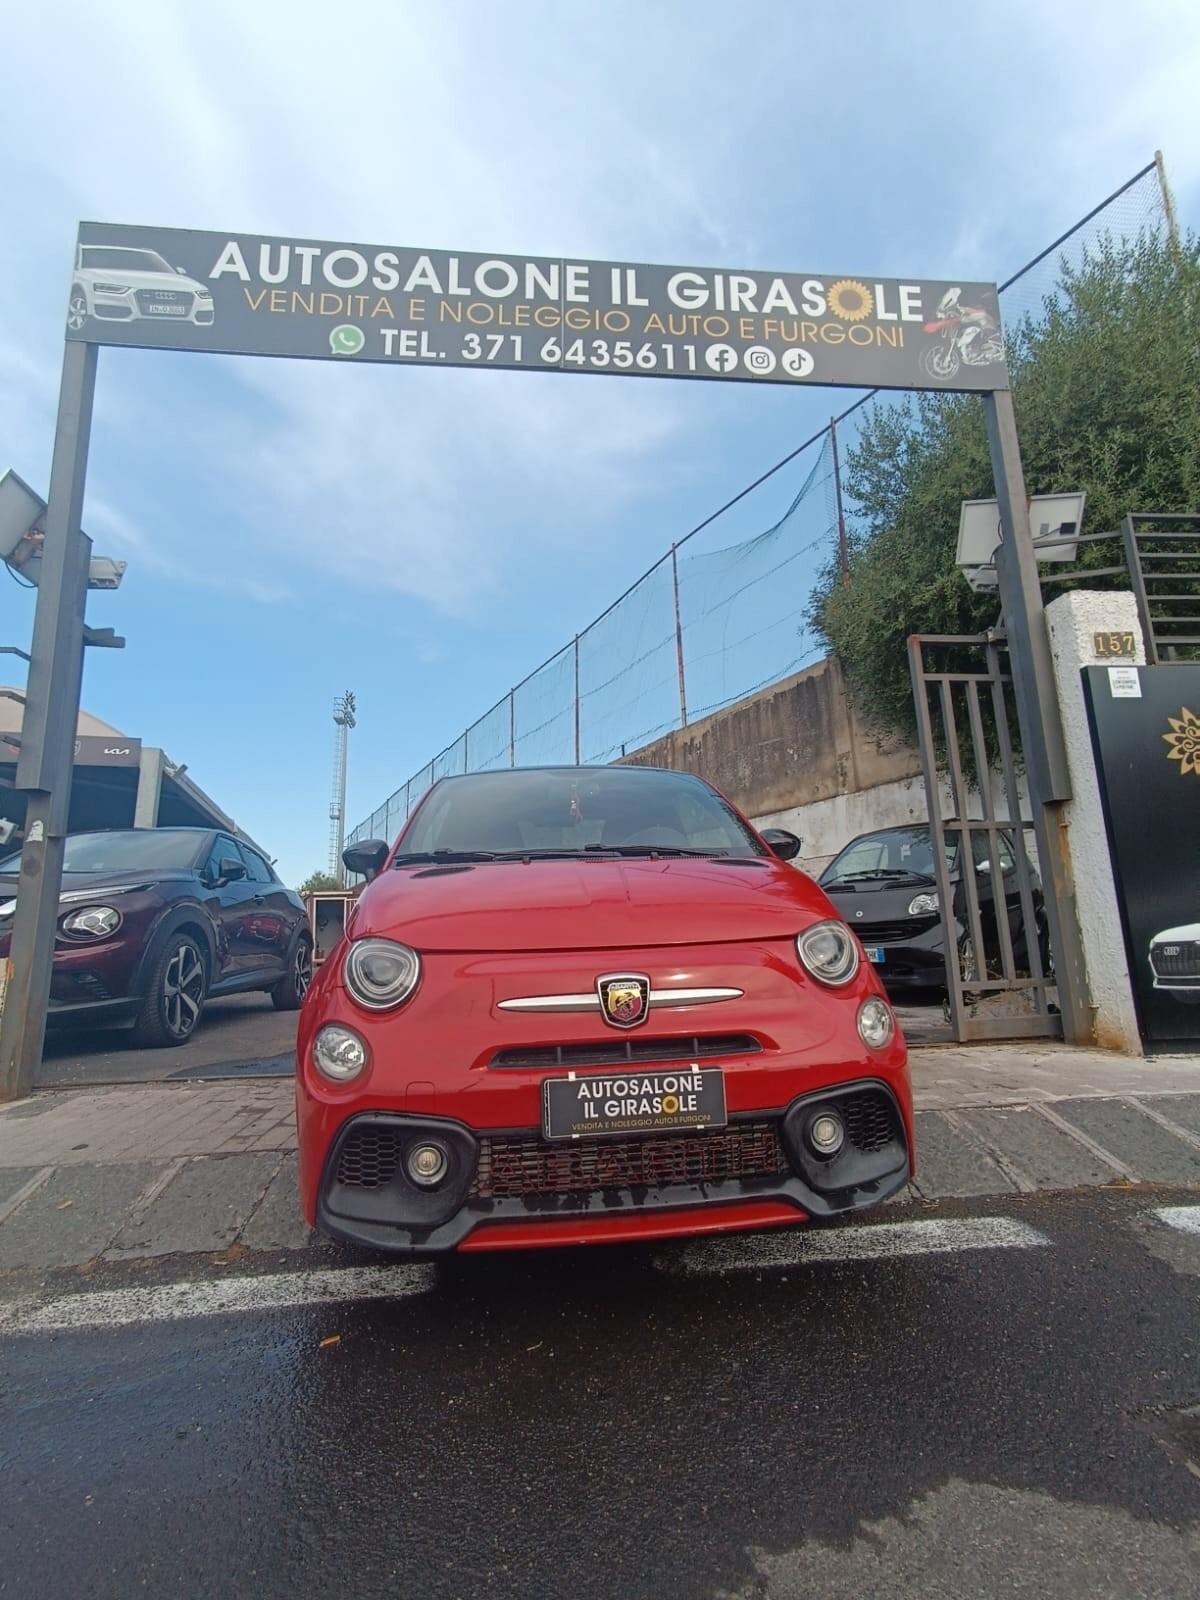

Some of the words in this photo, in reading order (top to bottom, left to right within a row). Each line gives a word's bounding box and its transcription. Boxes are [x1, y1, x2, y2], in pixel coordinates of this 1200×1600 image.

[209, 240, 590, 303] AUTOSALONE
[610, 266, 649, 307] IL
[667, 271, 924, 323] GIRASOLE
[243, 286, 396, 320] VENDITA
[409, 297, 426, 321] E
[439, 300, 631, 334] NOLEGGIO
[643, 312, 730, 338] AUTO
[739, 318, 756, 339] E
[764, 318, 905, 348] FURGONI
[380, 328, 446, 359] TEL.
[461, 332, 523, 362] 371
[540, 335, 697, 371] 6435611
[1096, 635, 1132, 652] 157
[577, 1075, 703, 1100] AUTOSALONE
[584, 1100, 599, 1119] IL
[604, 1094, 697, 1118] GIRASOLE
[572, 1122, 604, 1131] VENDITA
[611, 1118, 653, 1129] NOLEGGIO
[655, 1117, 674, 1125] AUTO
[679, 1114, 711, 1123] FURGONI
